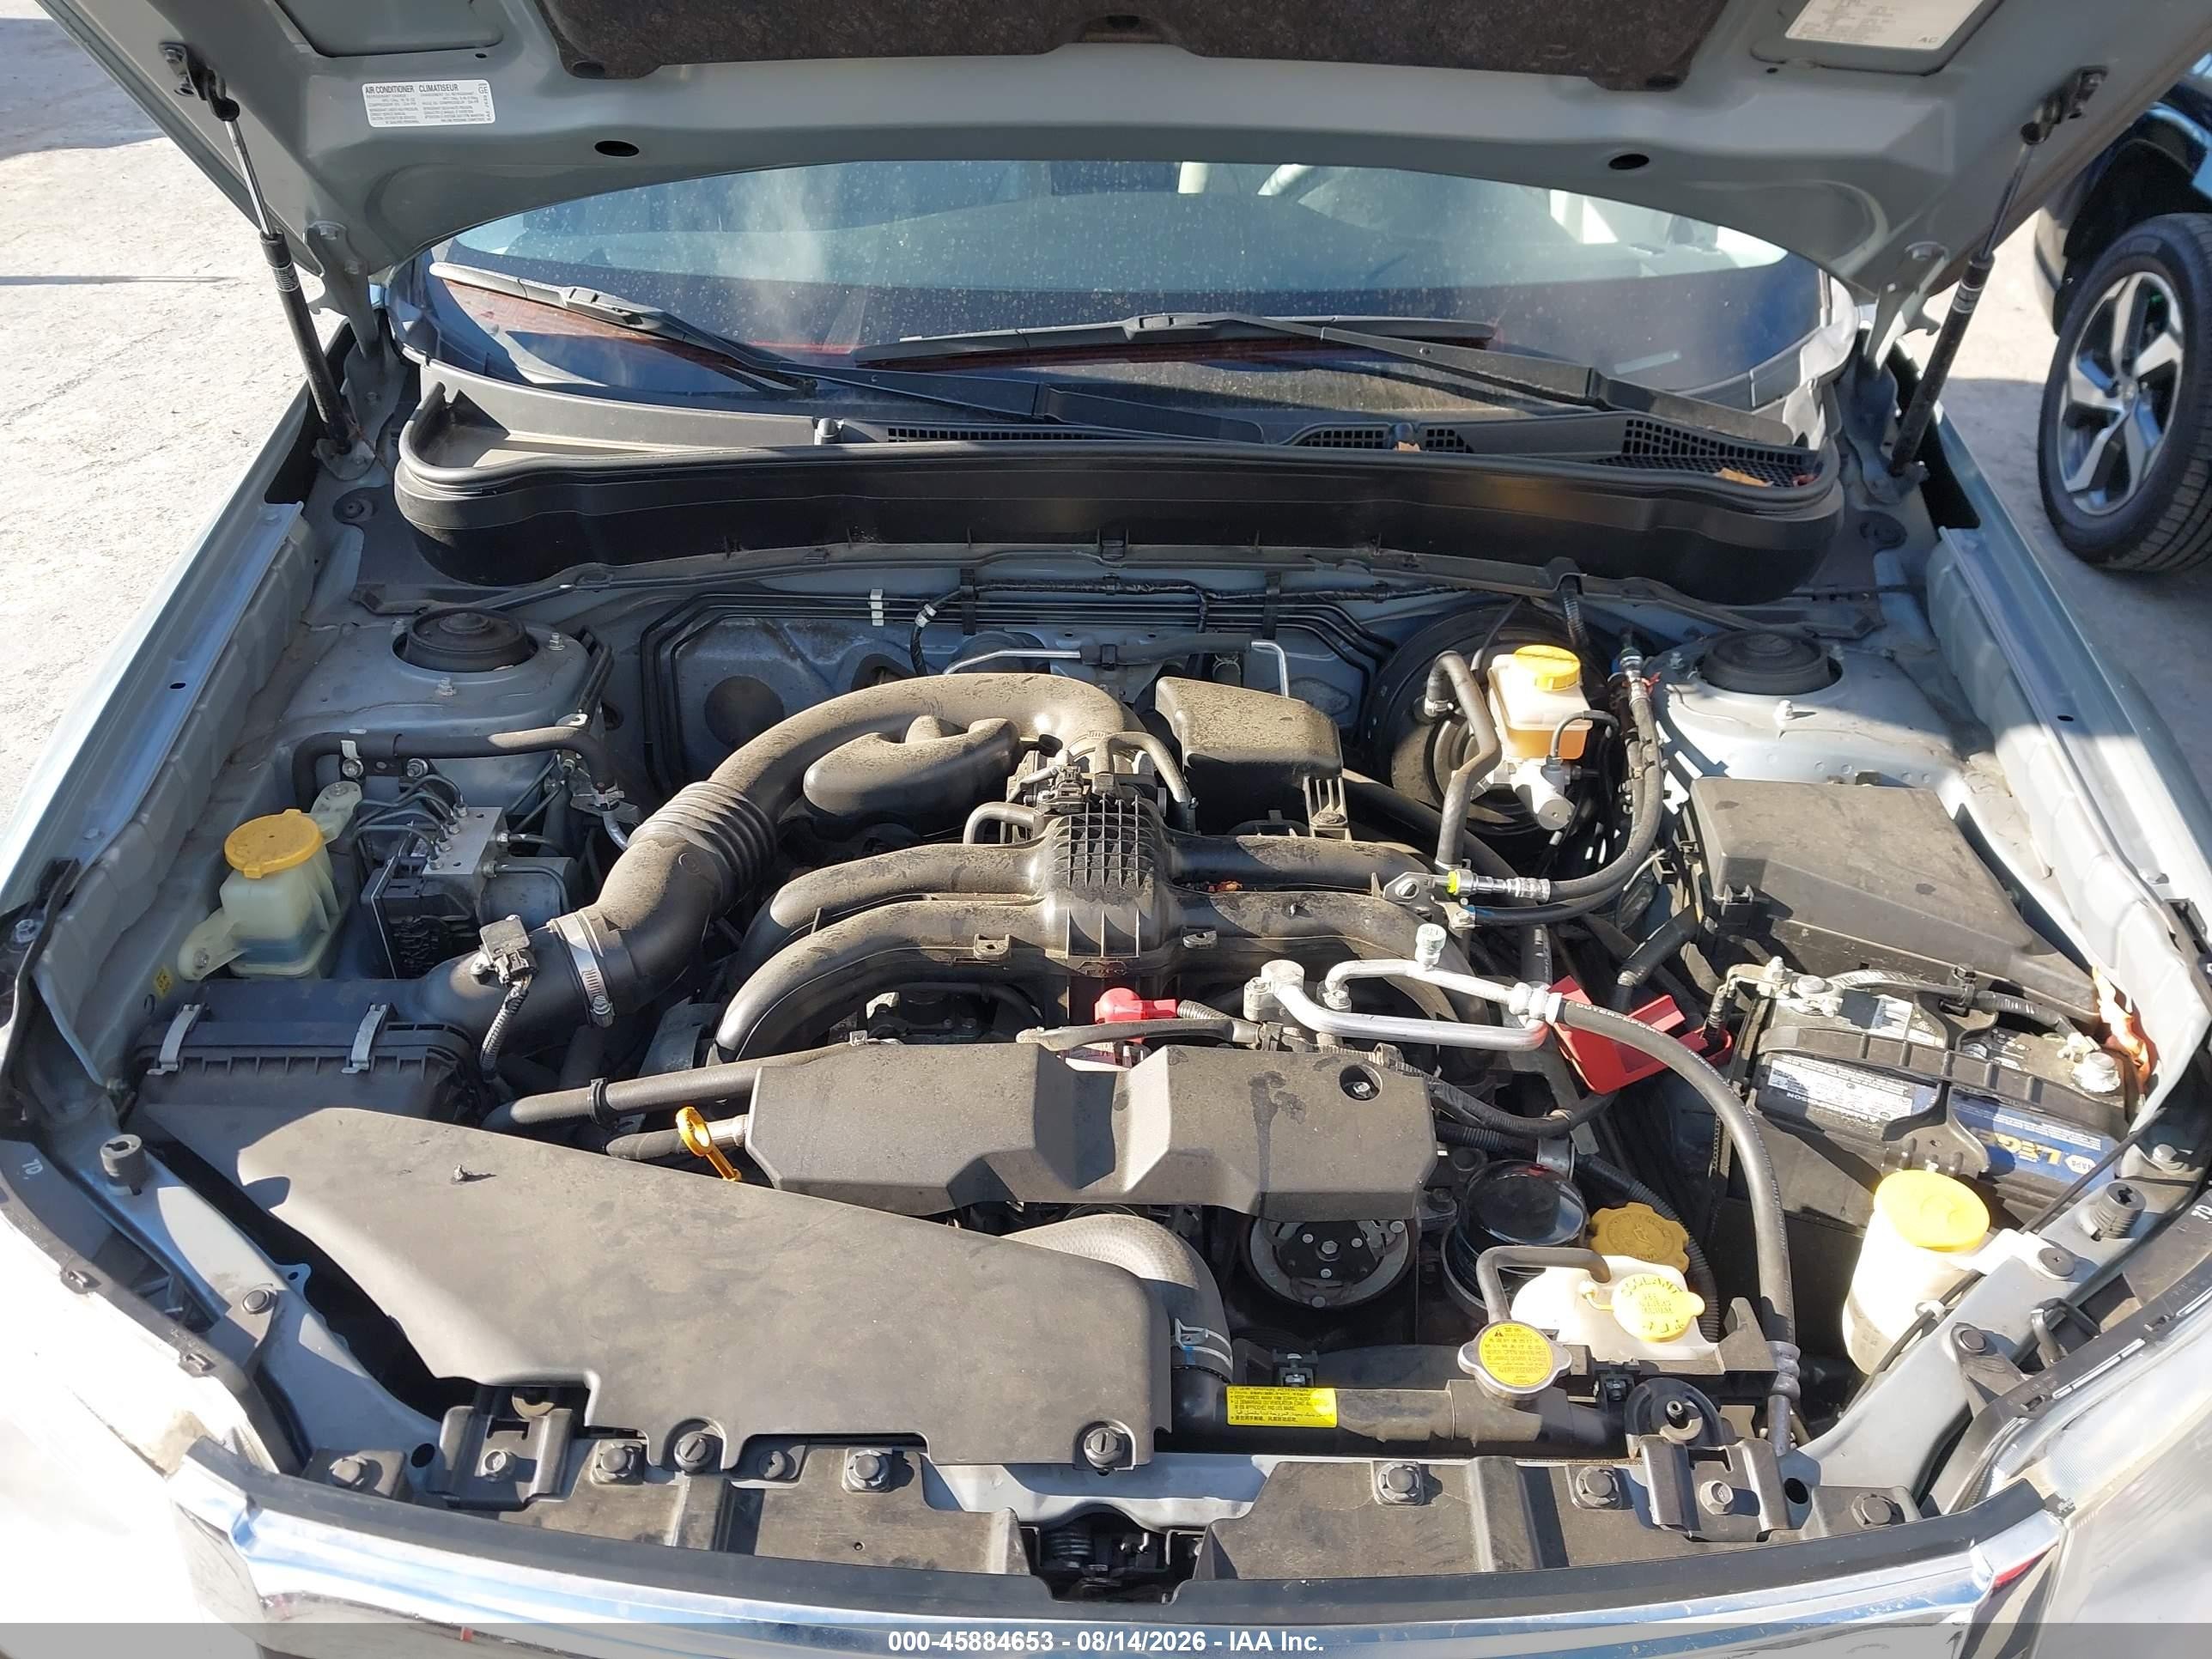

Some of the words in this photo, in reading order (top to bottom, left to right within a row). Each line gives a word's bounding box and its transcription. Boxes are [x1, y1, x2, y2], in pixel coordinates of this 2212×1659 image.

[366, 86, 375, 94] AIR
[375, 85, 415, 94] CONDITIONER
[418, 83, 459, 93] CLIMATISEUR
[477, 86, 489, 94] GE
